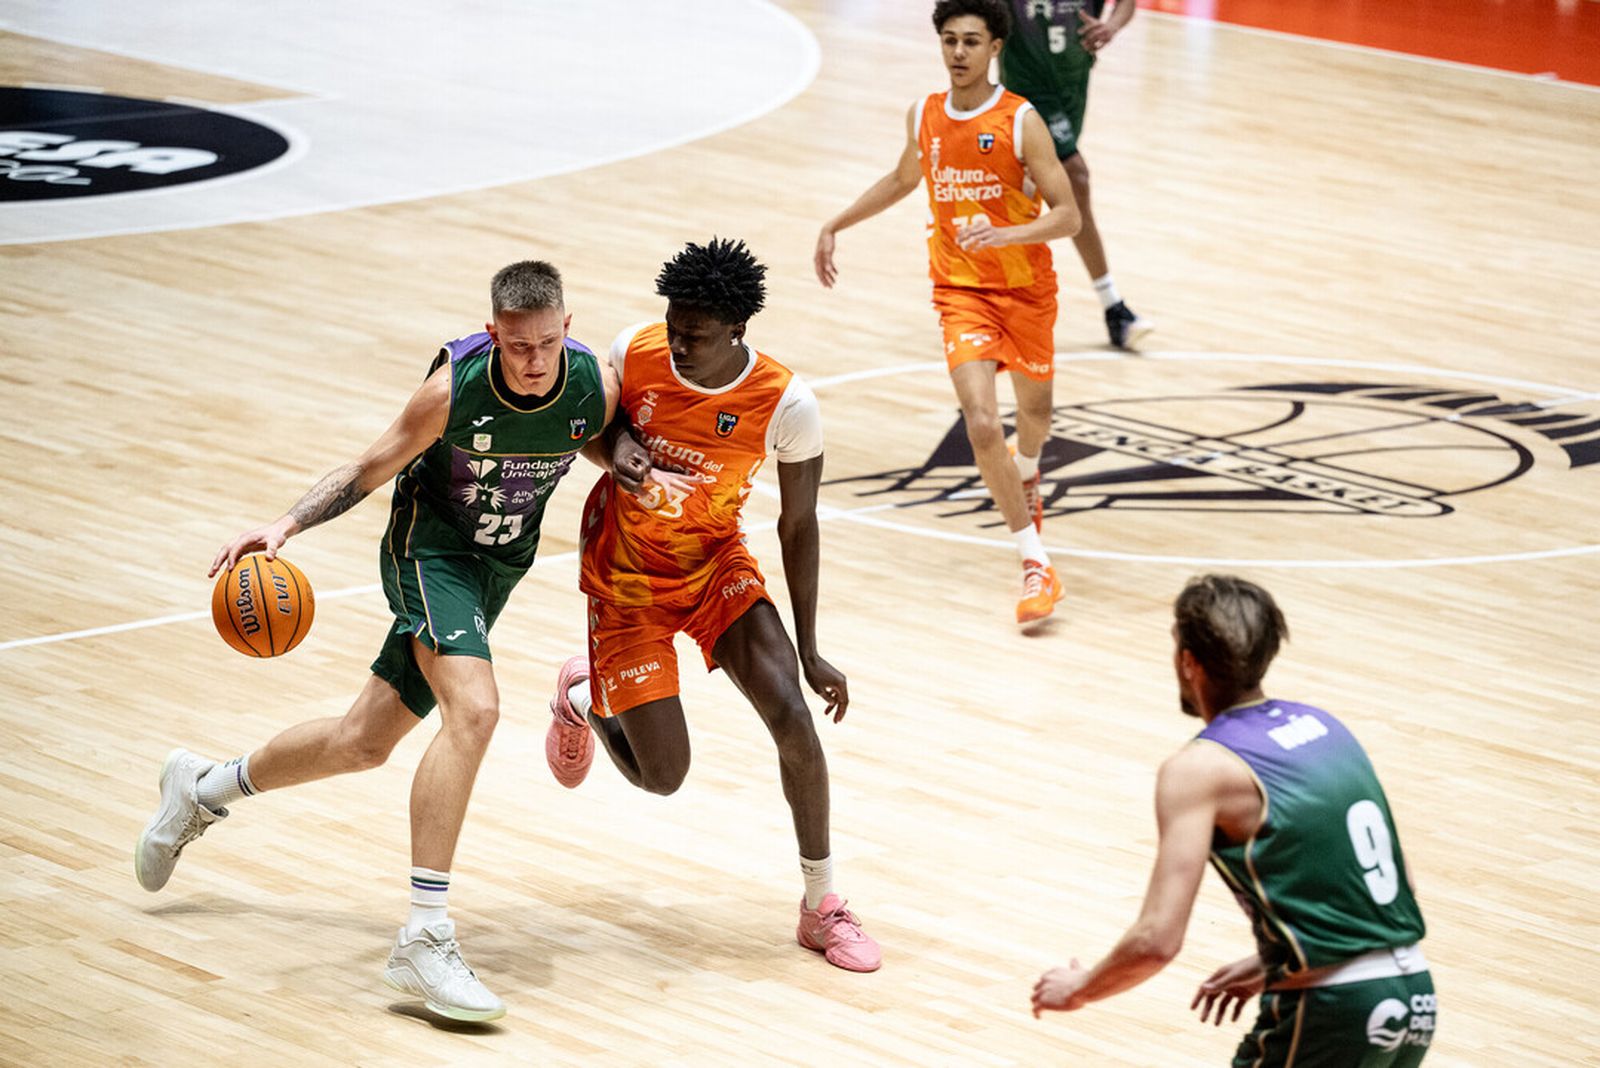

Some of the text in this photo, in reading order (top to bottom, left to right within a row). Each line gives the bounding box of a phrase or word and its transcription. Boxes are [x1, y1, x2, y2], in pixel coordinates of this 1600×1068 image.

[1047, 26, 1067, 54] 5
[931, 166, 984, 183] Cultura
[934, 183, 1002, 202] Esfuerzo
[719, 412, 738, 424] LIGA
[703, 460, 725, 473] del
[1226, 464, 1424, 509] BASKET
[637, 484, 690, 518] 33
[473, 512, 524, 546] 23
[236, 567, 261, 637] Wilson
[619, 660, 662, 681] PULEVA
[1346, 799, 1399, 906] 9
